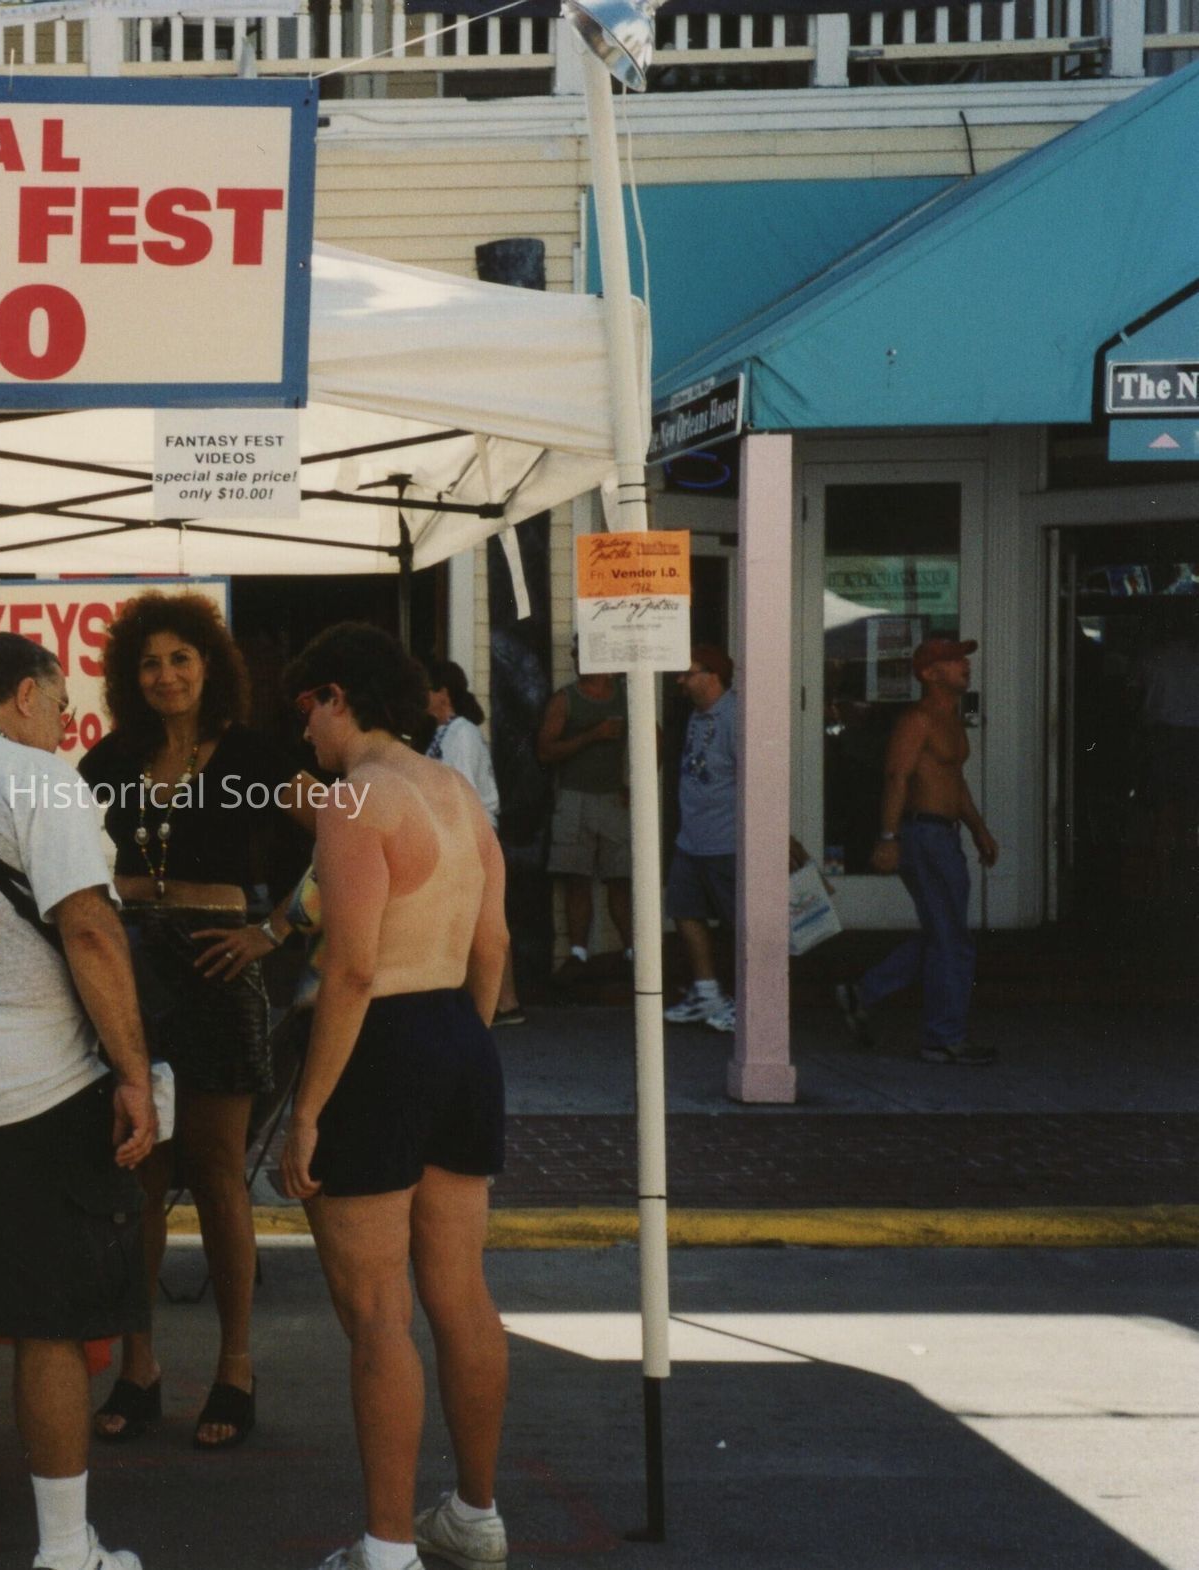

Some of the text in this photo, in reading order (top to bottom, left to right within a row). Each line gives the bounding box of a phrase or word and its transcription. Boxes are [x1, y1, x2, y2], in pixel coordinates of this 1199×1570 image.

[18, 186, 283, 266] FEST
[1117, 372, 1171, 400] The
[165, 435, 284, 447] FANTASY FEST
[194, 452, 256, 464] VIDEOS
[155, 470, 297, 484] special sale price!
[178, 487, 274, 502] only $10.00!
[611, 568, 658, 579] Vendor
[661, 567, 680, 578] I.D.
